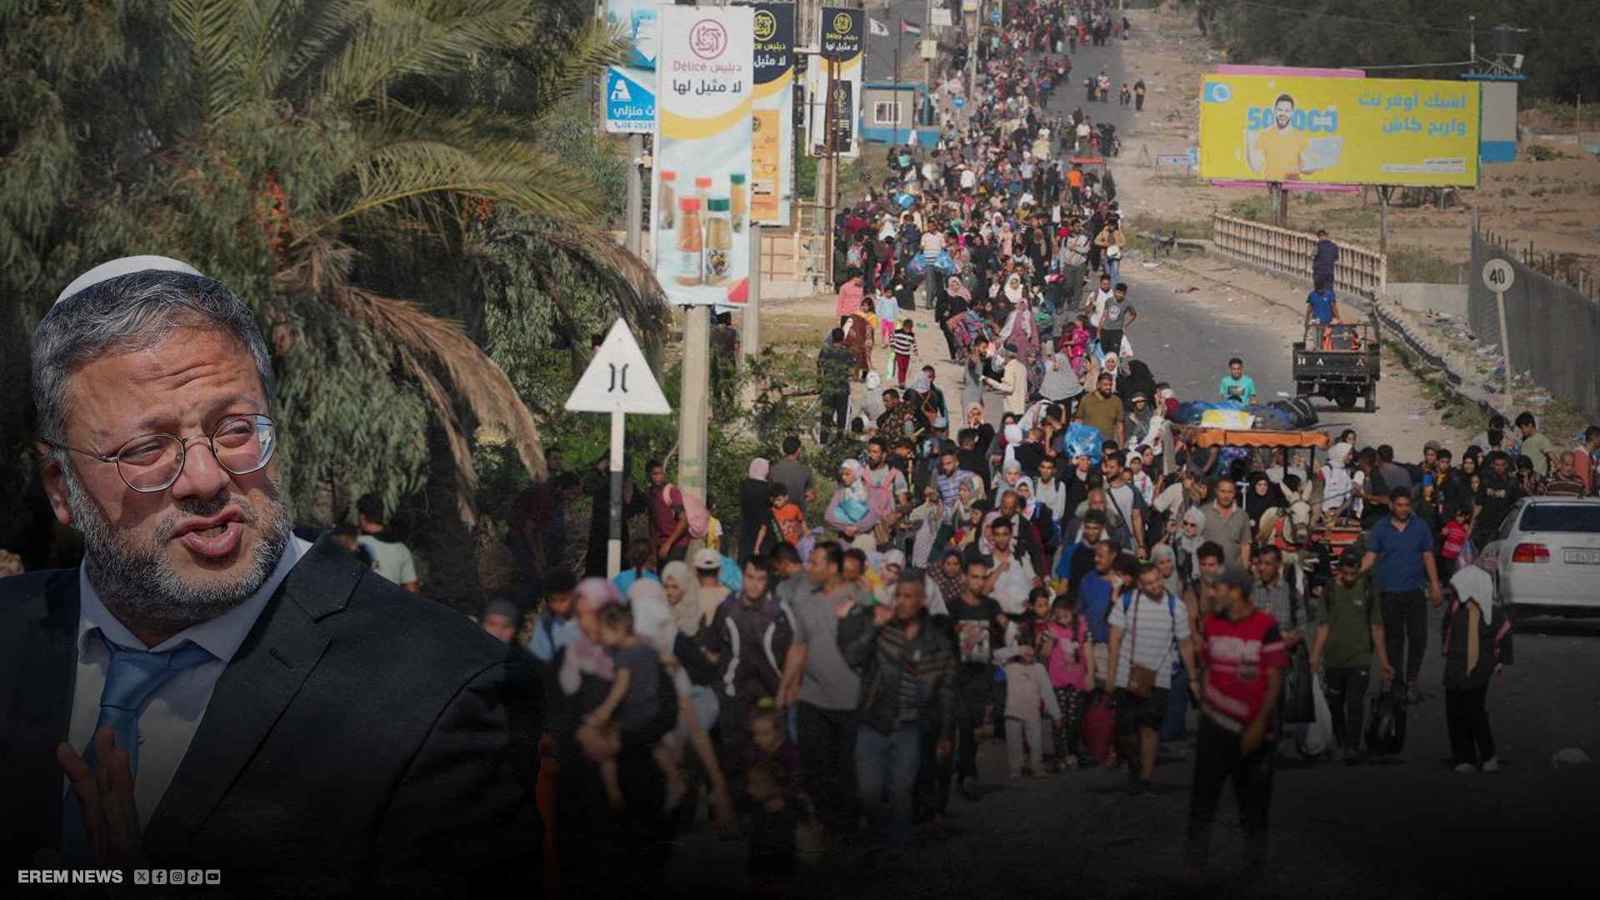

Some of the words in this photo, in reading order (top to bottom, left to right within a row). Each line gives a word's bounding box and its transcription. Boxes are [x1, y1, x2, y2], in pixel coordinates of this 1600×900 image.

[754, 54, 776, 68] مثيل
[778, 56, 786, 66] لا
[673, 80, 691, 95] لها
[695, 78, 727, 96] مثيل
[730, 80, 742, 93] لا
[1489, 268, 1505, 285] 40
